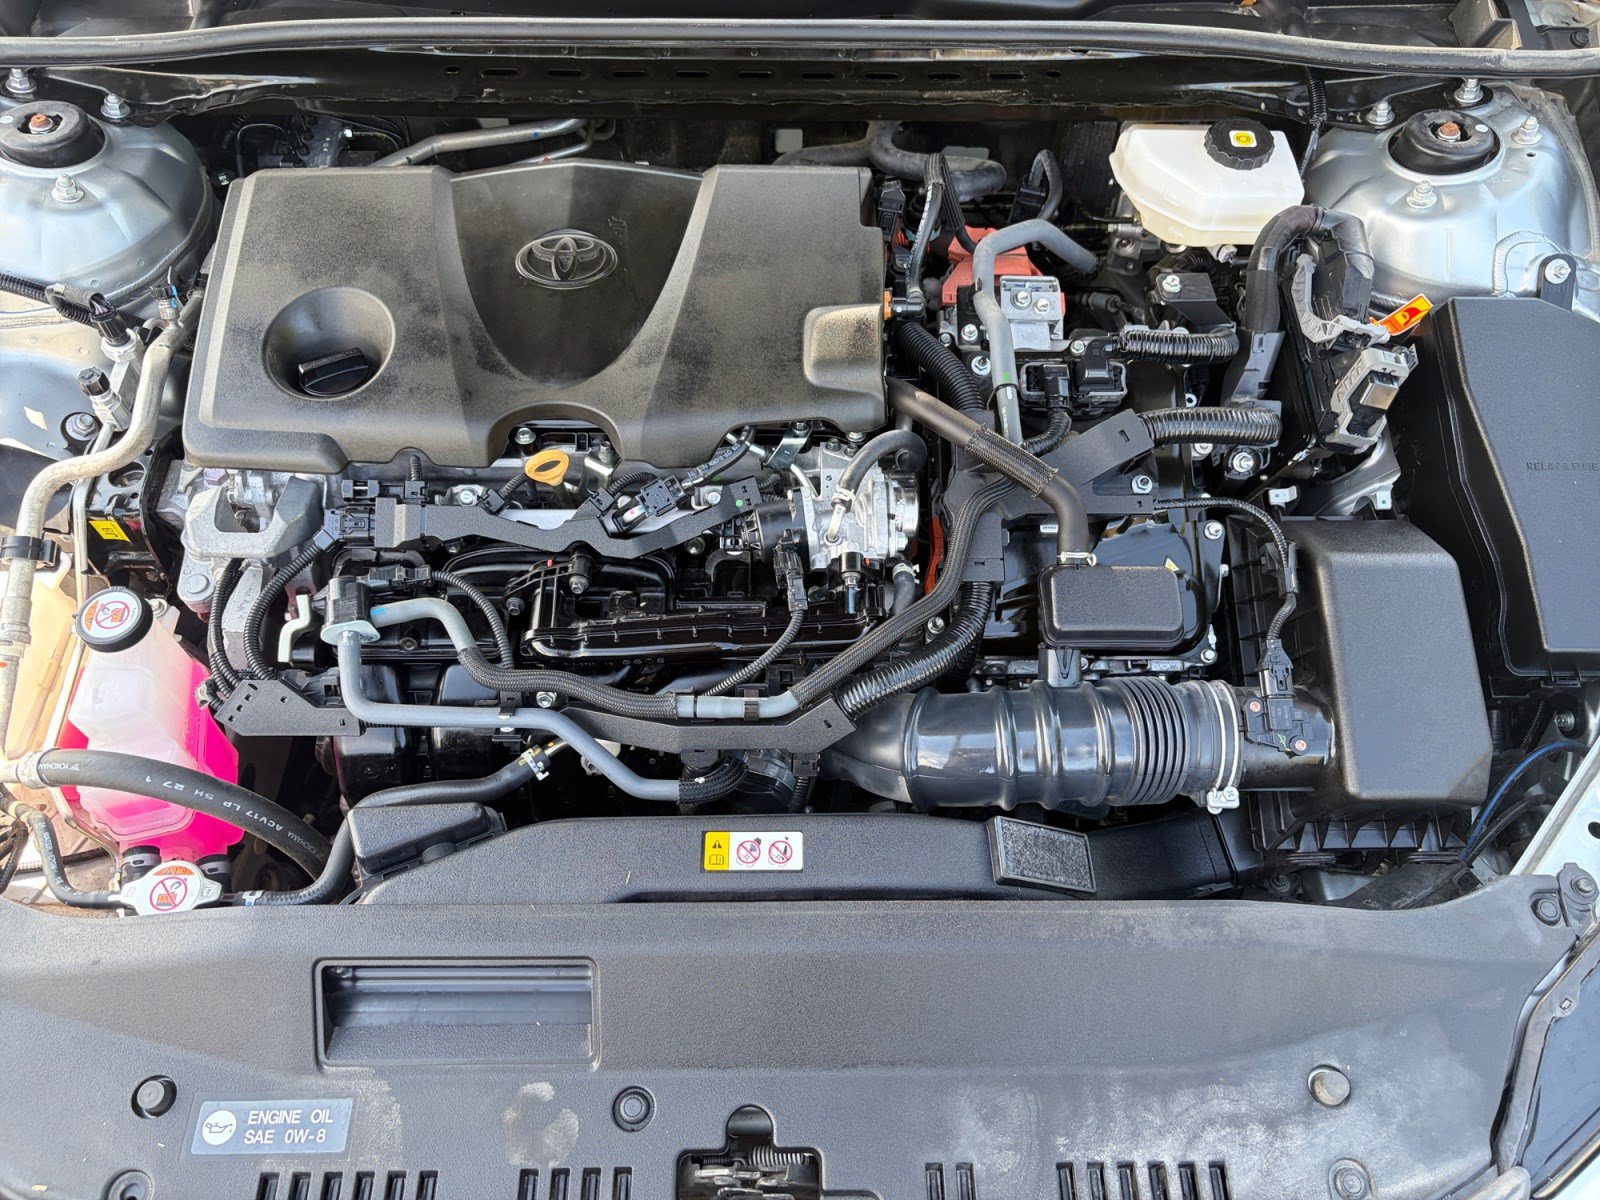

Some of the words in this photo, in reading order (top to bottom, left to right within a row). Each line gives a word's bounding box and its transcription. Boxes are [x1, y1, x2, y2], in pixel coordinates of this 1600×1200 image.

[1571, 462, 1599, 471] FUSE
[38, 762, 70, 771] YOKOHAM
[145, 775, 152, 783] 1
[162, 780, 185, 792] 27
[222, 801, 241, 812] LP
[245, 810, 284, 832] ACV17
[247, 1110, 302, 1125] ENGINE
[310, 1109, 334, 1124] OIL
[244, 1129, 275, 1144] SAE
[284, 1128, 326, 1144] 0W-8
